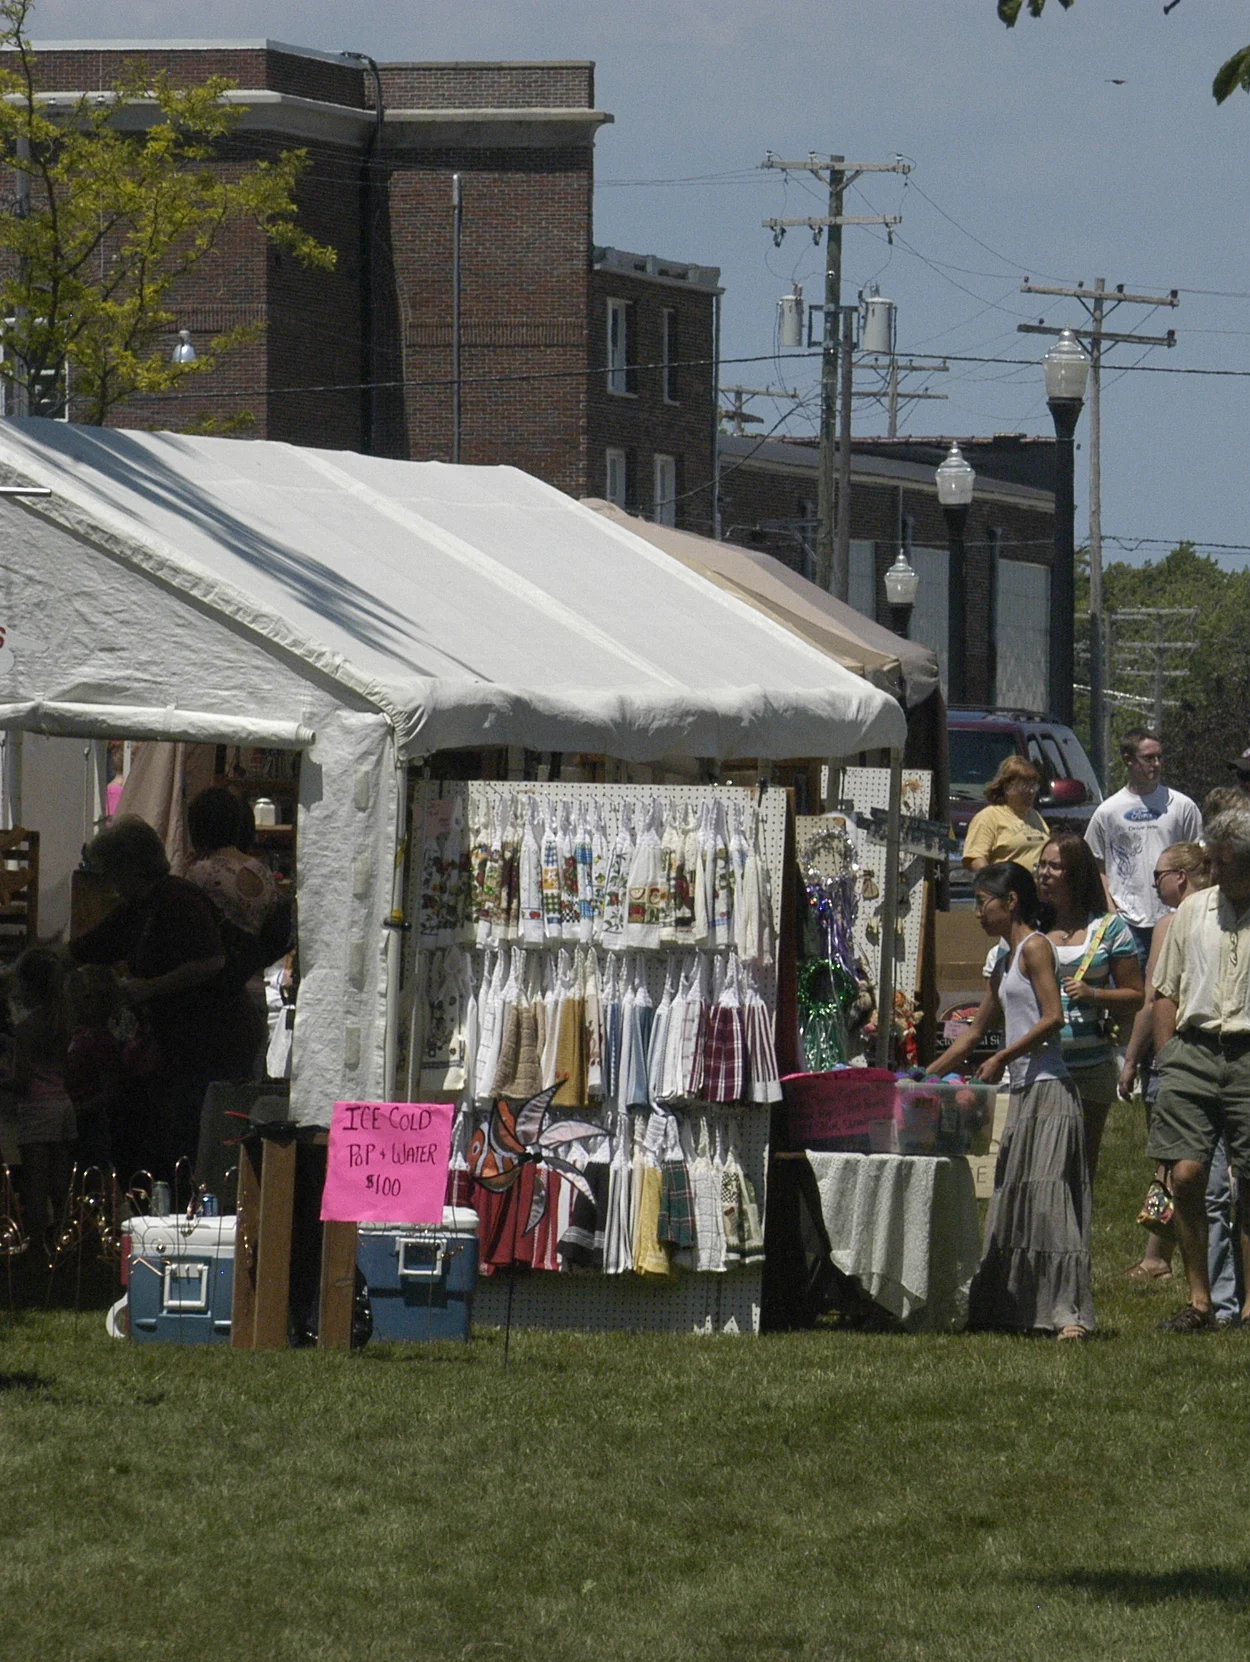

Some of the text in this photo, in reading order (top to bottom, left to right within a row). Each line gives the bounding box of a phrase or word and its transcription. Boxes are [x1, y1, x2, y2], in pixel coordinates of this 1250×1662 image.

[343, 1106, 432, 1131] ICE COLD
[348, 1143, 376, 1168] POP
[391, 1143, 438, 1166] WATER
